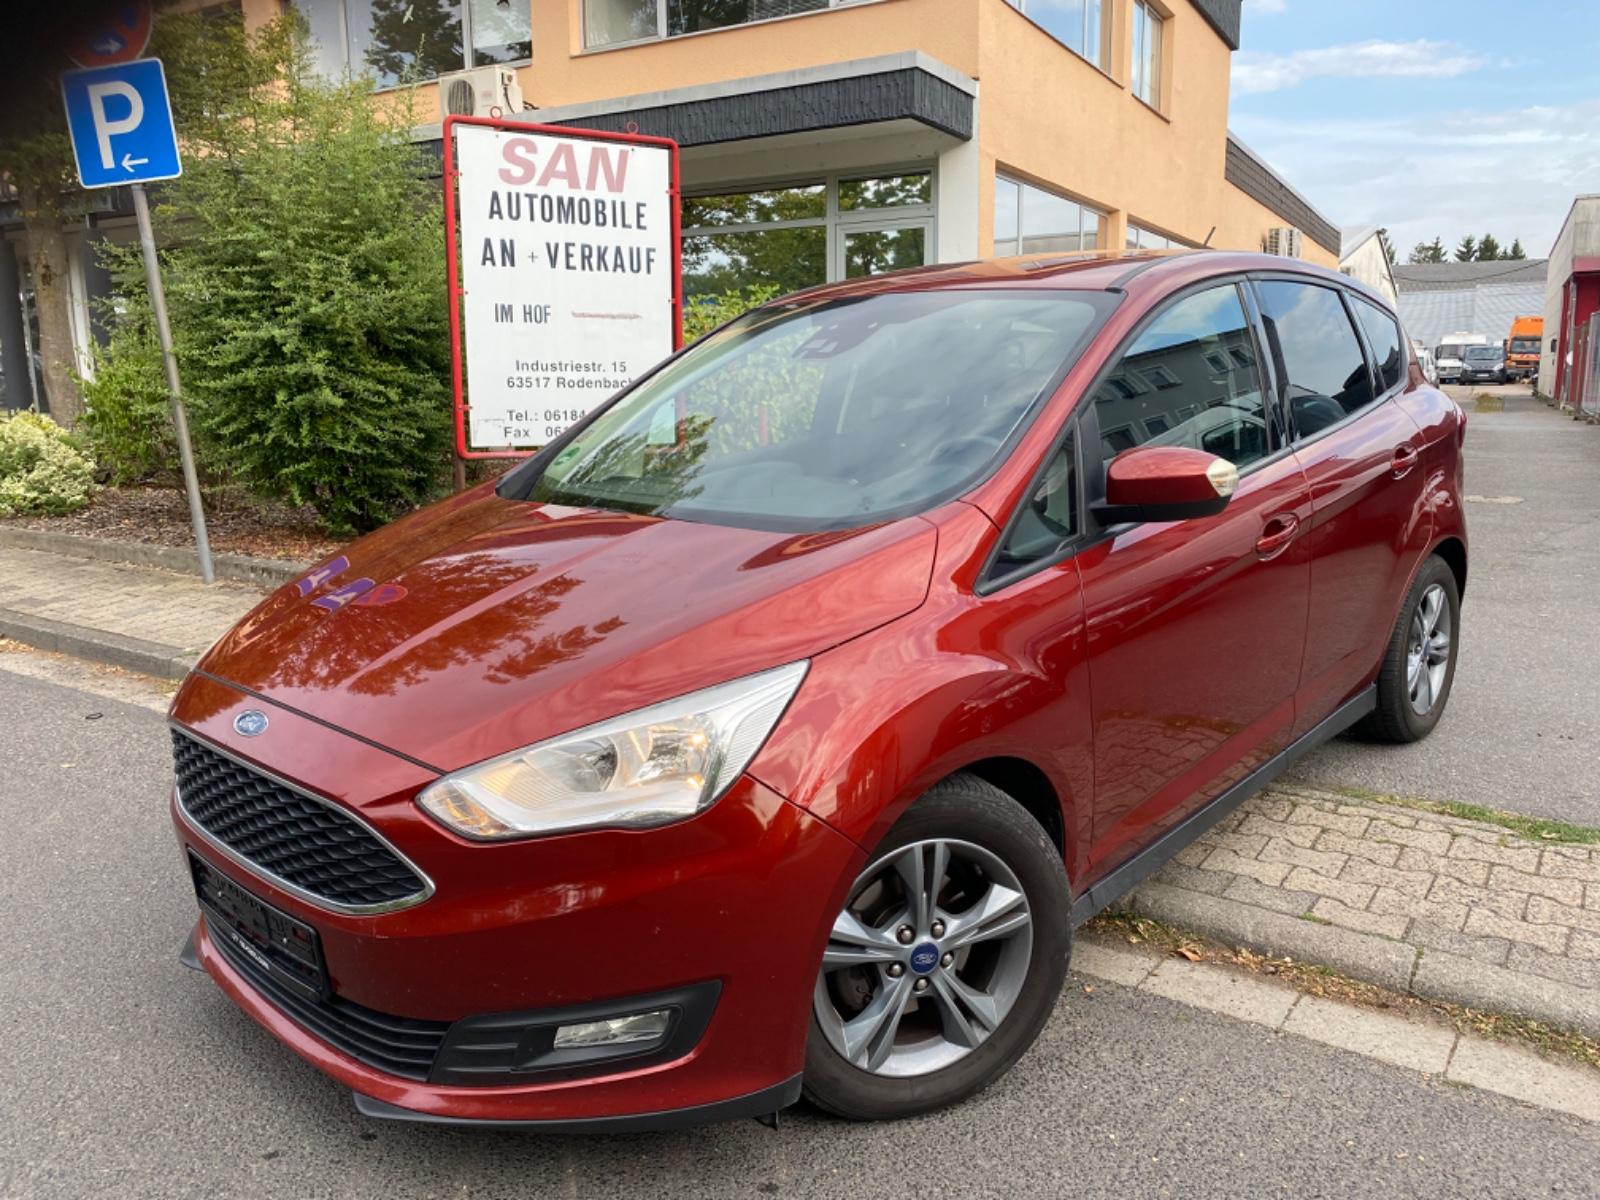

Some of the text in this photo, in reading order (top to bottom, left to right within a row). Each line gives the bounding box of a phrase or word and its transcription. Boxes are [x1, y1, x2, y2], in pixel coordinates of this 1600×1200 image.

[87, 80, 144, 169] P
[498, 138, 629, 193] SAN
[488, 191, 647, 230] AUTOMOBILE
[481, 238, 516, 267] AN
[545, 242, 657, 275] VERKAUF
[494, 303, 551, 324] IM HOF
[515, 360, 627, 373] Industriestr. 15
[507, 376, 550, 388] 63517
[507, 410, 539, 421] Tel.:
[504, 426, 530, 438] Fax
